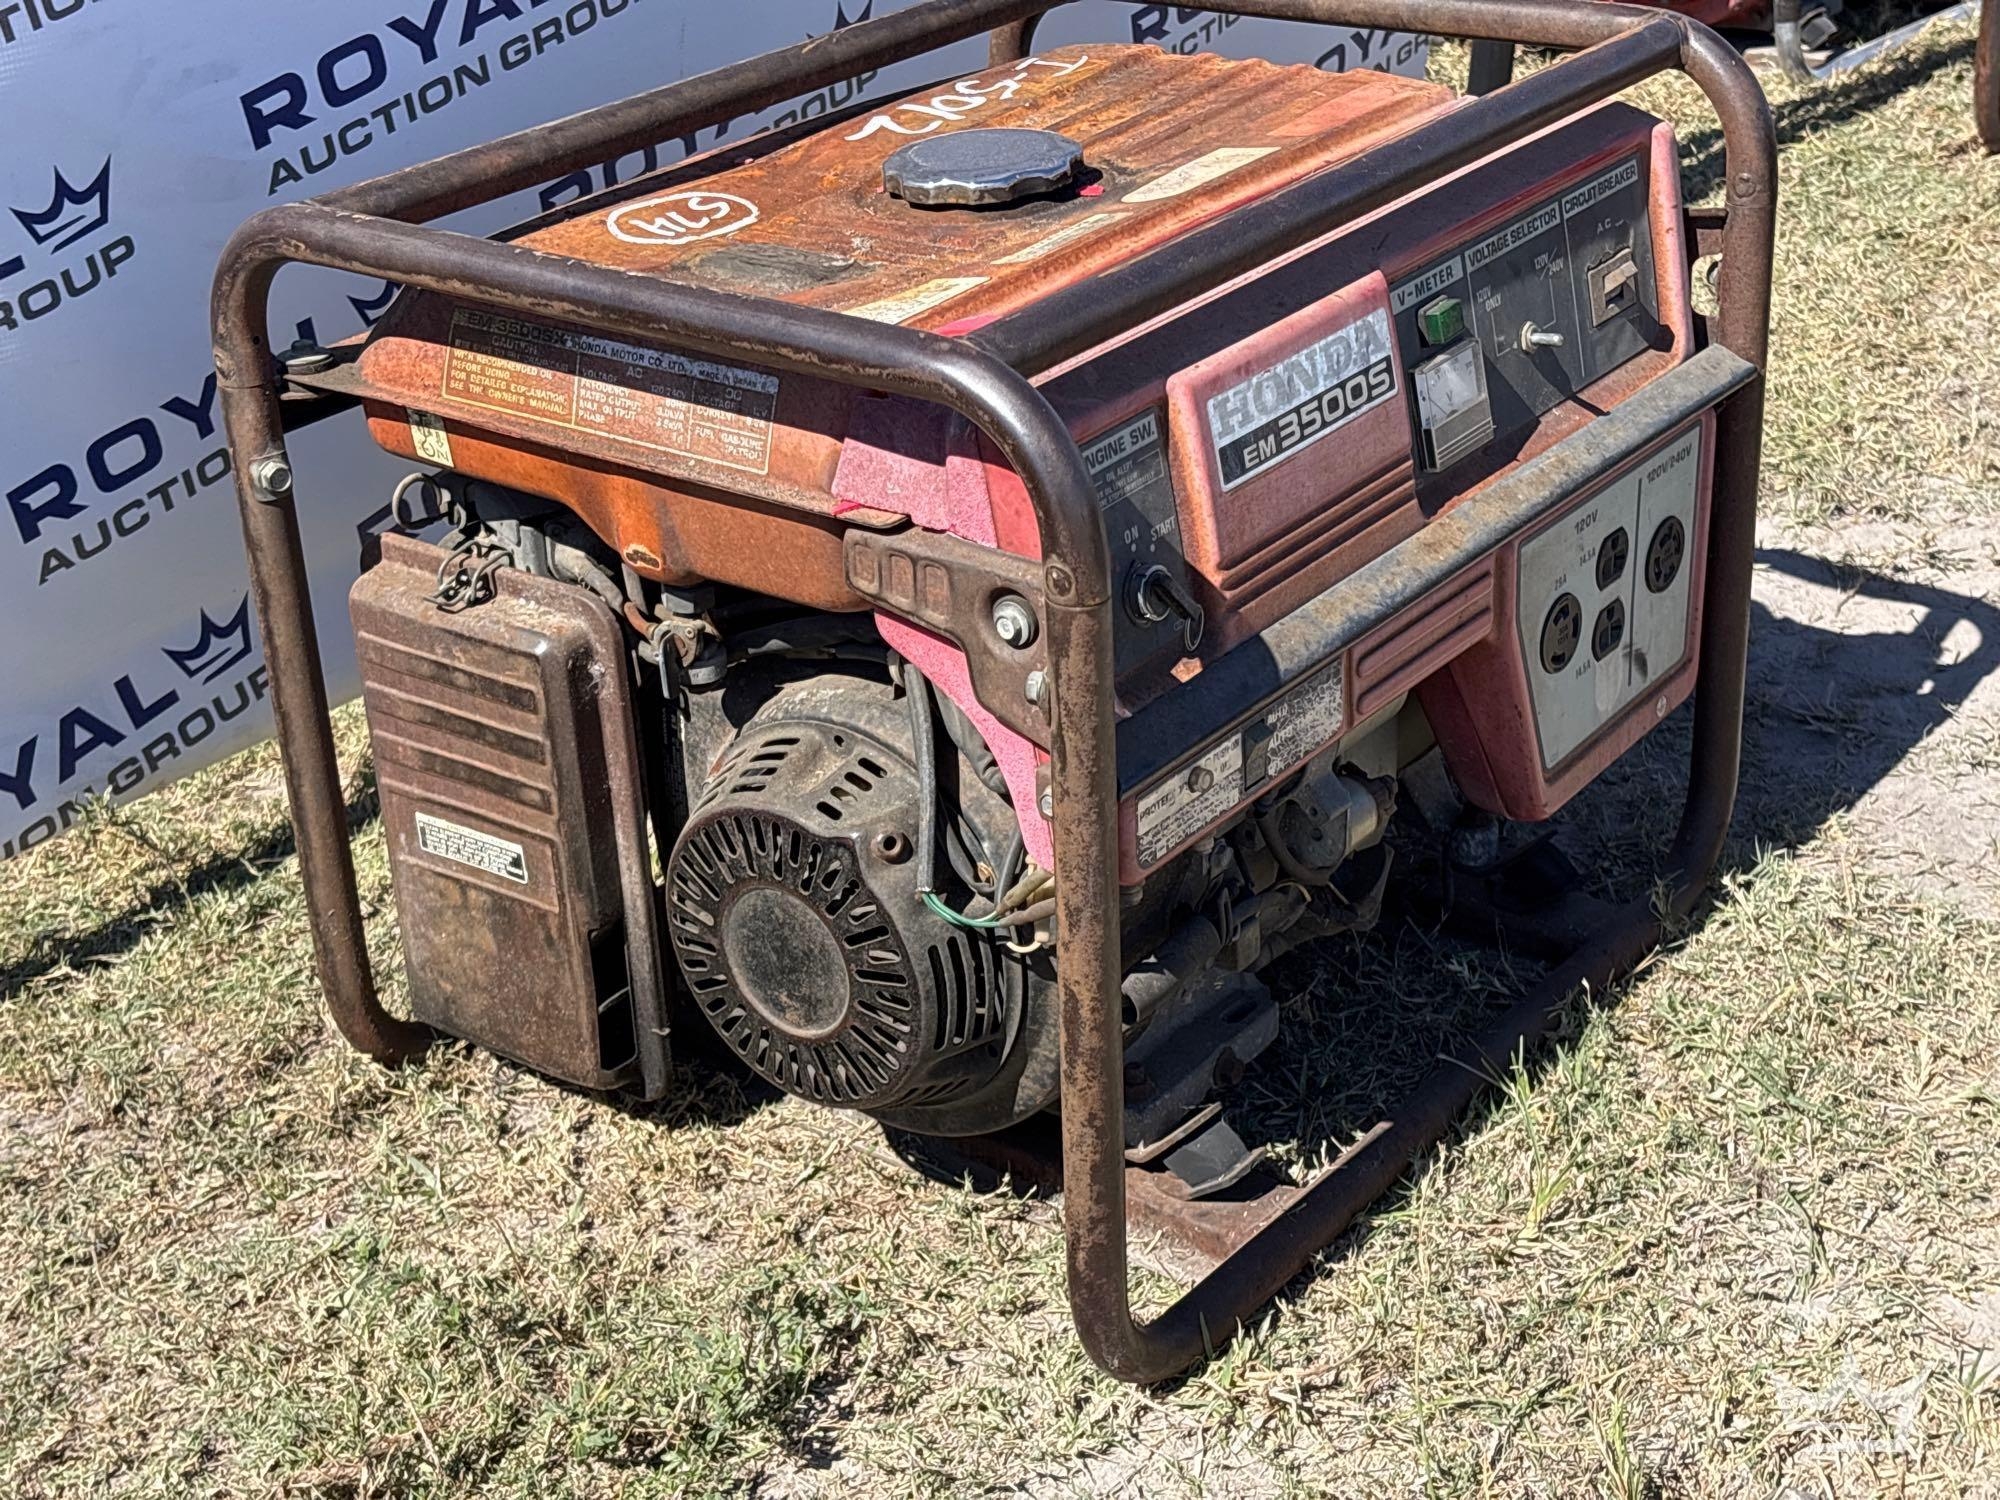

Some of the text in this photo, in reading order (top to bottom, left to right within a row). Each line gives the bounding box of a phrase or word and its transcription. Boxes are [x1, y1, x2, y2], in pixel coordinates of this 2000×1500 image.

[239, 0, 555, 151] ROYA
[268, 55, 490, 197] AUCTION
[500, 0, 642, 71] GROU
[1564, 167, 1637, 216] CIRCUIT BREAKER
[1468, 210, 1558, 268] VOLTAGE SELECTOR
[1397, 271, 1454, 307] V-METER
[610, 346, 646, 364] MOTOR
[449, 379, 465, 391] SEE
[1214, 318, 1389, 441] HONDA
[1085, 420, 1155, 469] NGINE SW.
[1647, 443, 1693, 484] 120V/240V
[38, 447, 232, 585] AUCTIO
[1124, 526, 1139, 544] ON
[1151, 516, 1176, 541] START
[1574, 508, 1599, 535] 120V
